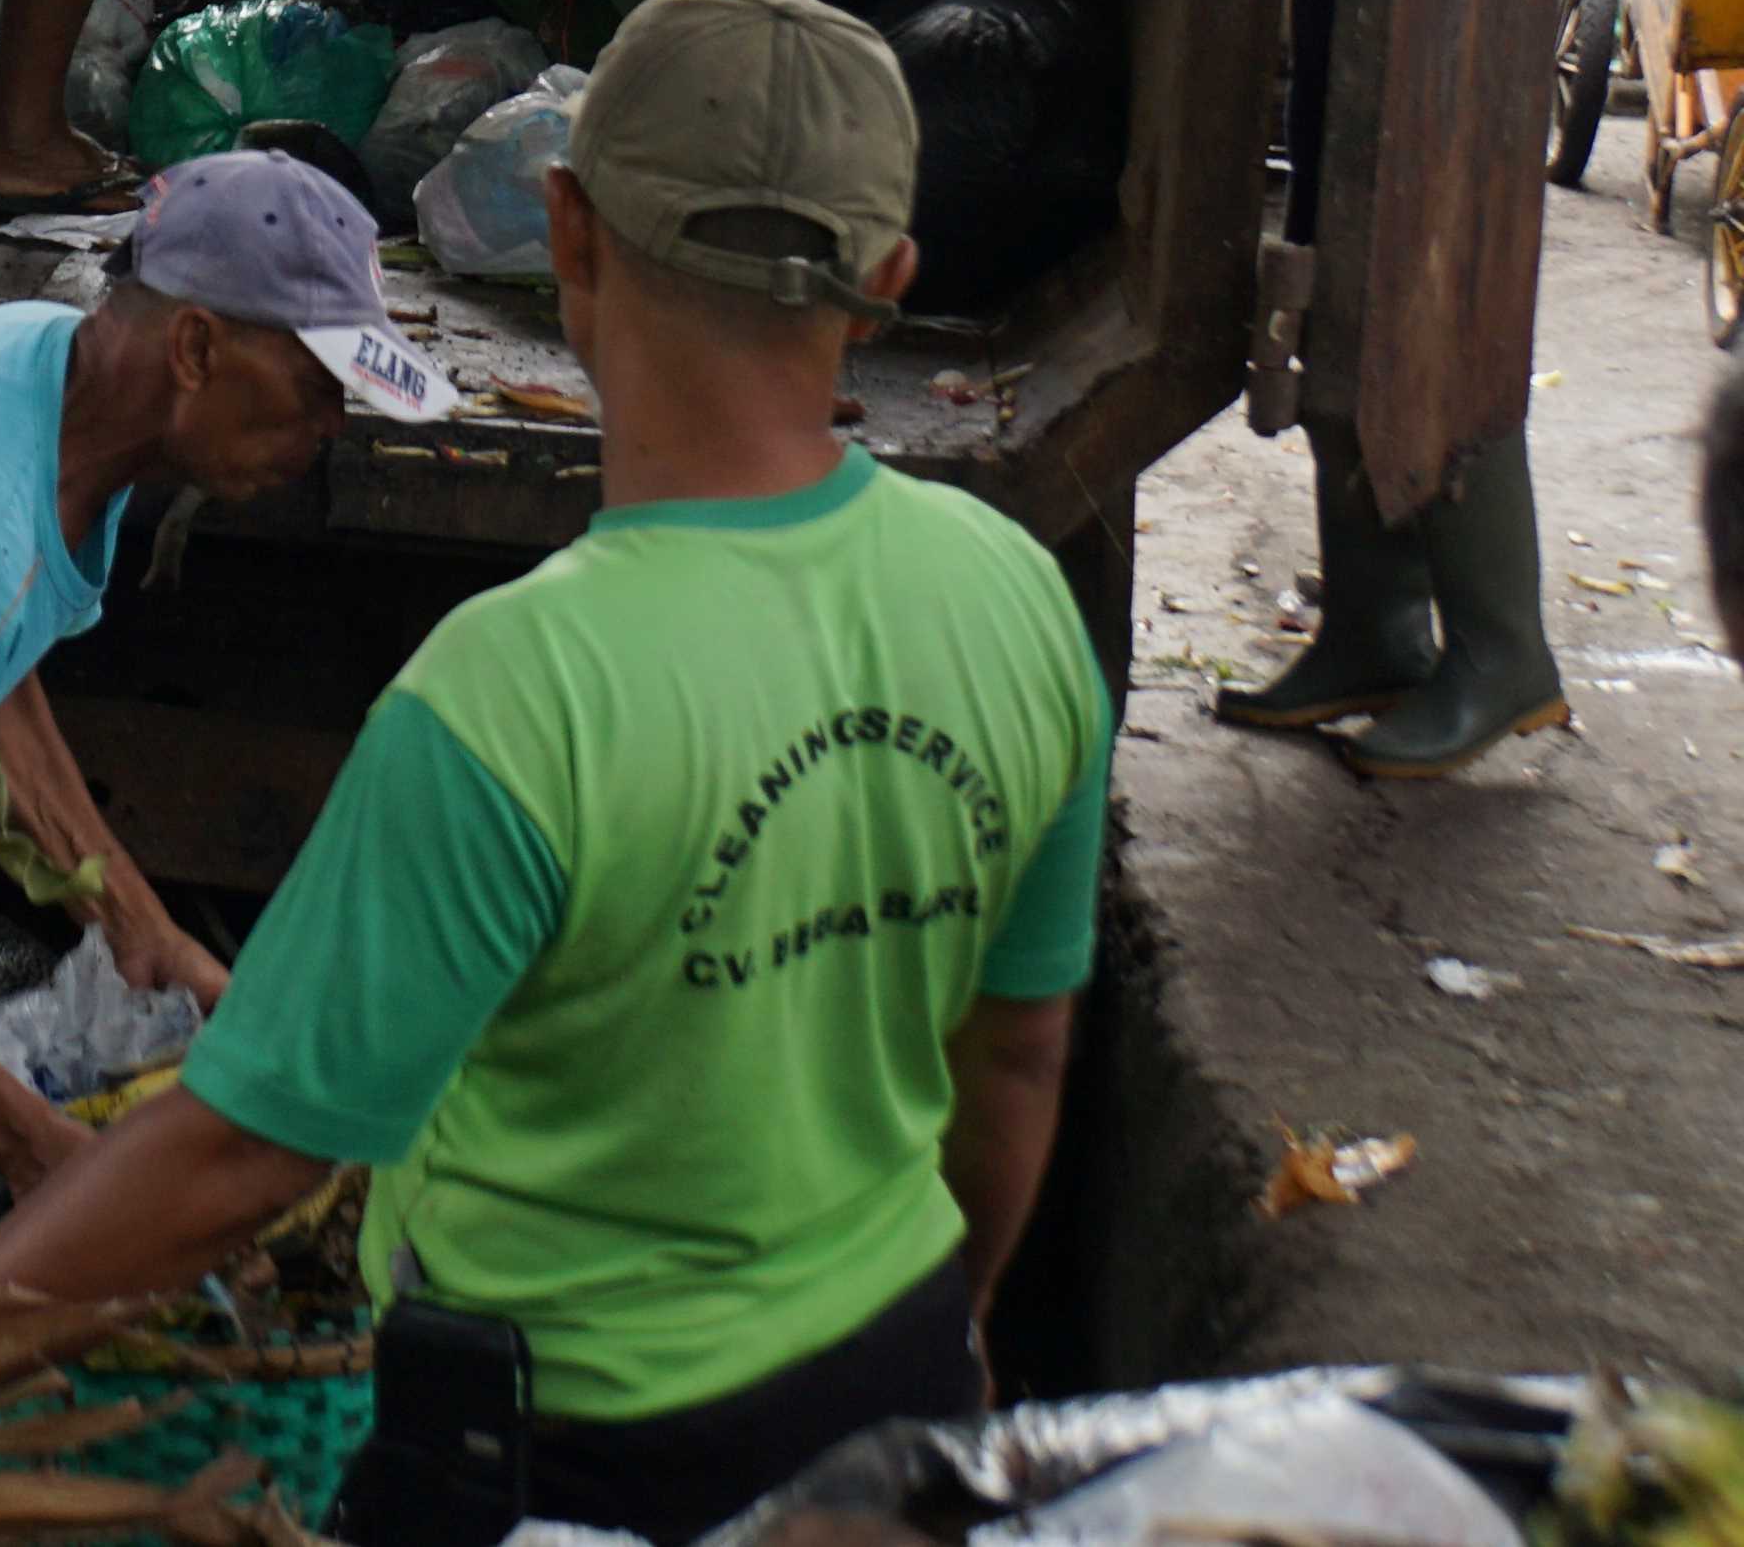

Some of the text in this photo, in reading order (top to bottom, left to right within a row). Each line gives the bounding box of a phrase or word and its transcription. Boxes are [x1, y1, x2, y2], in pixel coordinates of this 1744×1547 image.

[354, 331, 427, 400] ELANG
[857, 706, 1007, 855] SERVICE
[683, 948, 754, 989] CV
